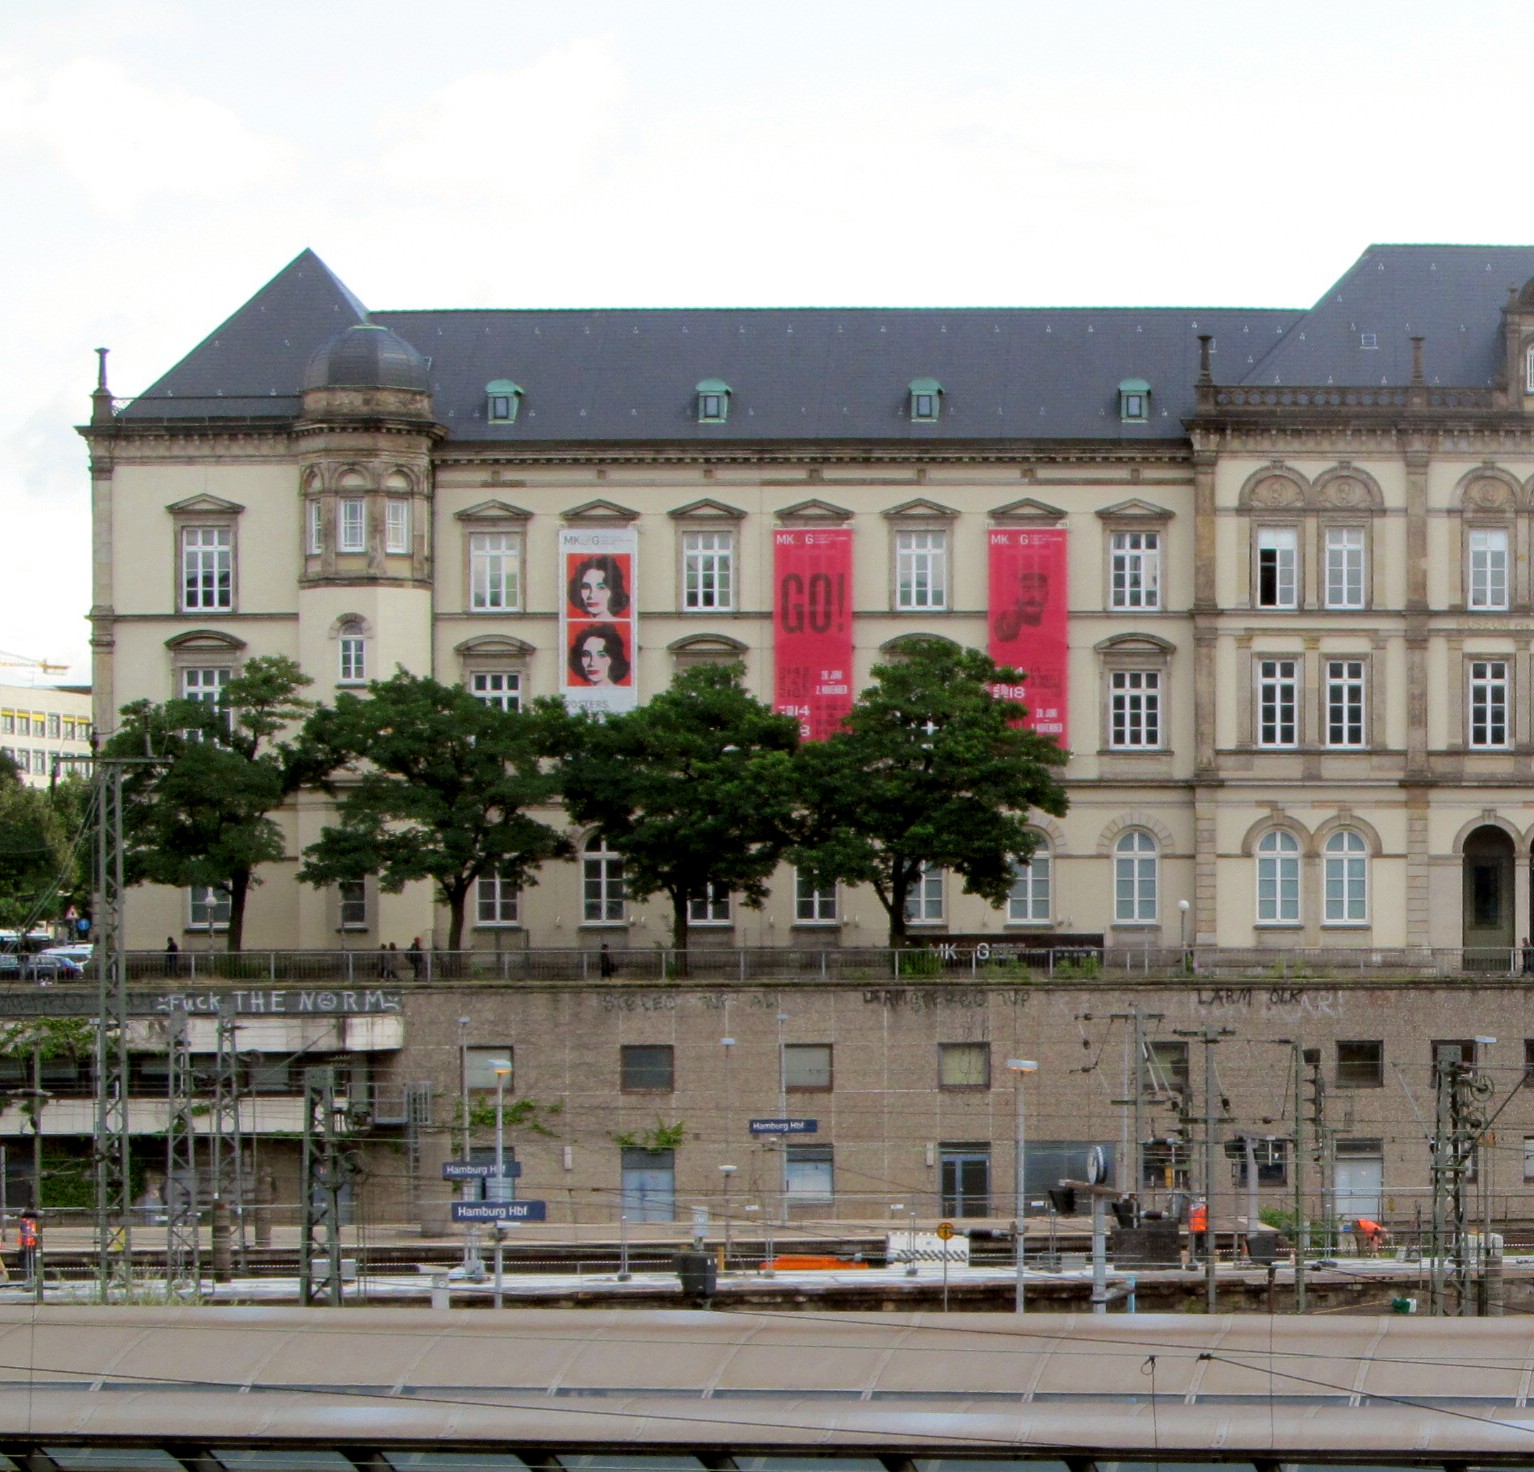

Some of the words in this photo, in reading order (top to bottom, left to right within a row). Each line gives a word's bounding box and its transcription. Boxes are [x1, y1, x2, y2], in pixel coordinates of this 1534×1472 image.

[781, 573, 845, 633] GO!
[232, 991, 286, 1012] THE
[753, 1121, 789, 1131] Hamburg
[446, 1165, 487, 1176] Hamburg
[489, 1164, 506, 1173] Hf
[458, 1206, 506, 1218] Hamburg
[508, 1206, 528, 1216] Hbf
